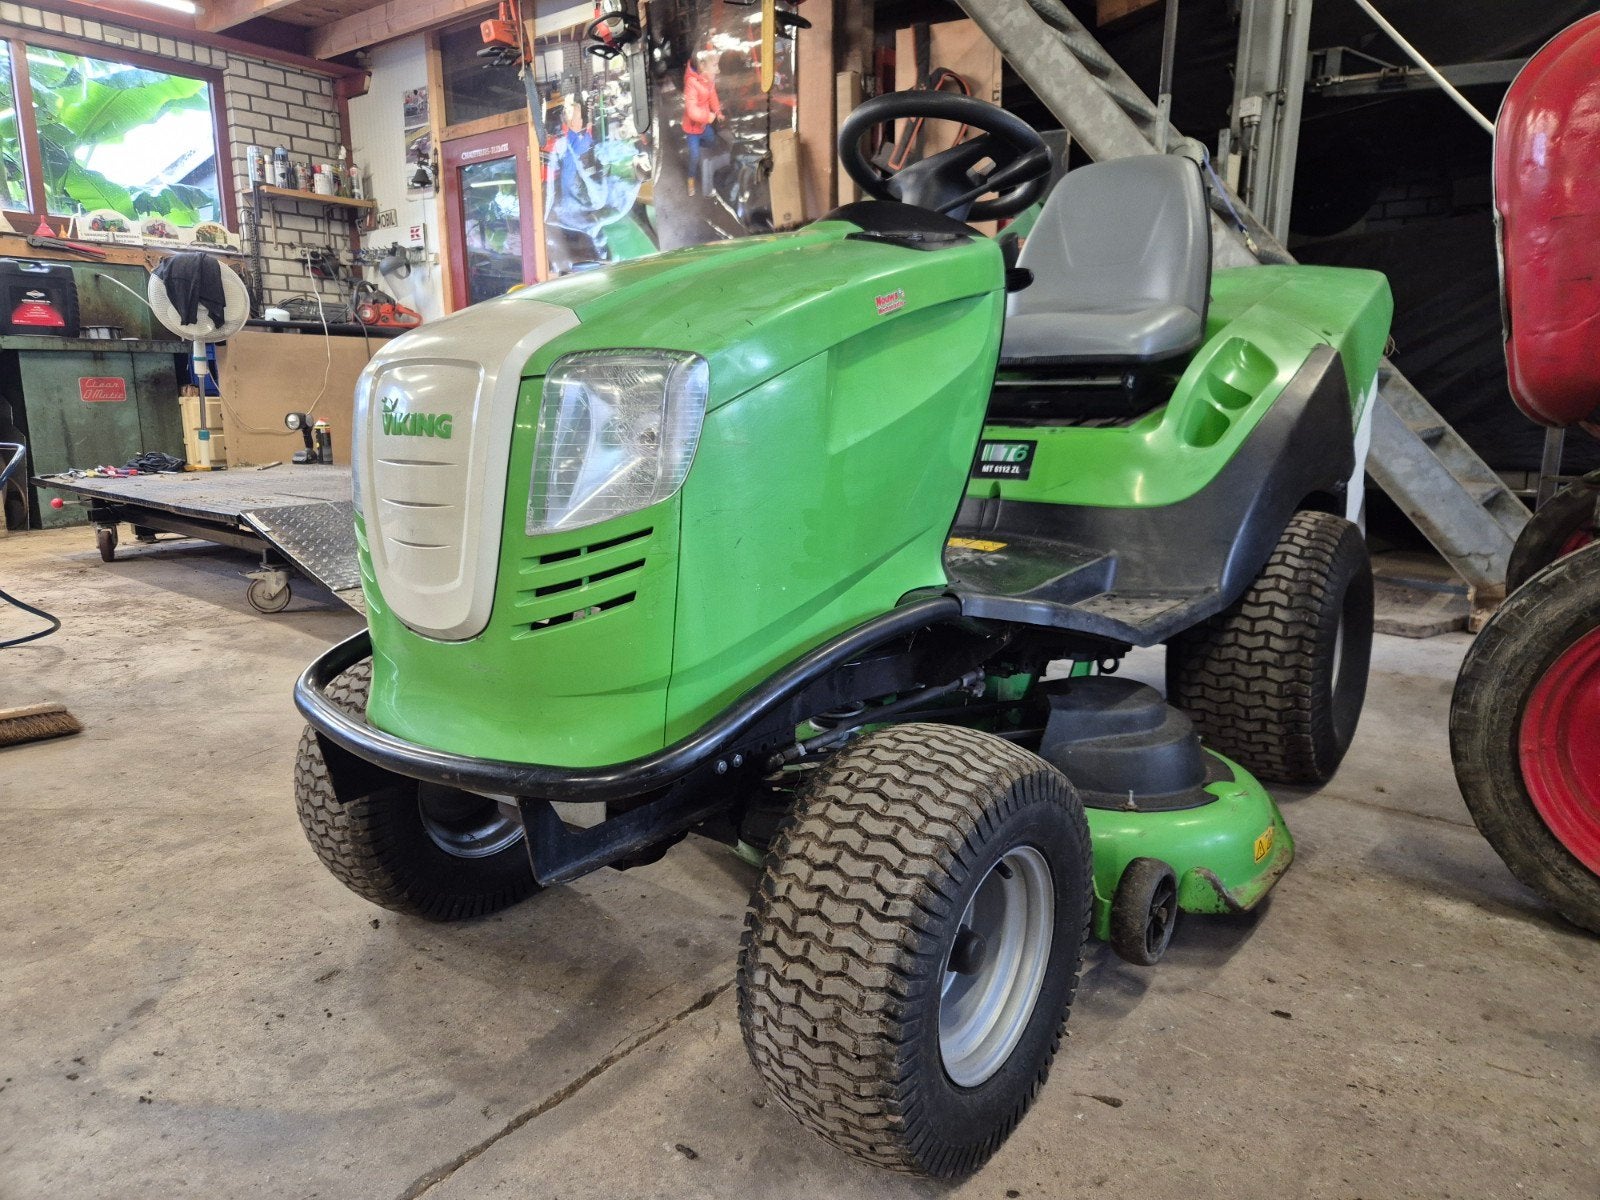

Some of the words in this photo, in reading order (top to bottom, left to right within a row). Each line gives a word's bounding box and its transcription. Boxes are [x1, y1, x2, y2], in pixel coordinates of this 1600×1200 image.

[86, 378, 120, 388] Clean
[382, 412, 452, 439] VIKING
[981, 465, 994, 473] MT
[994, 465, 1011, 473] 6112
[1010, 466, 1020, 474] ZL
